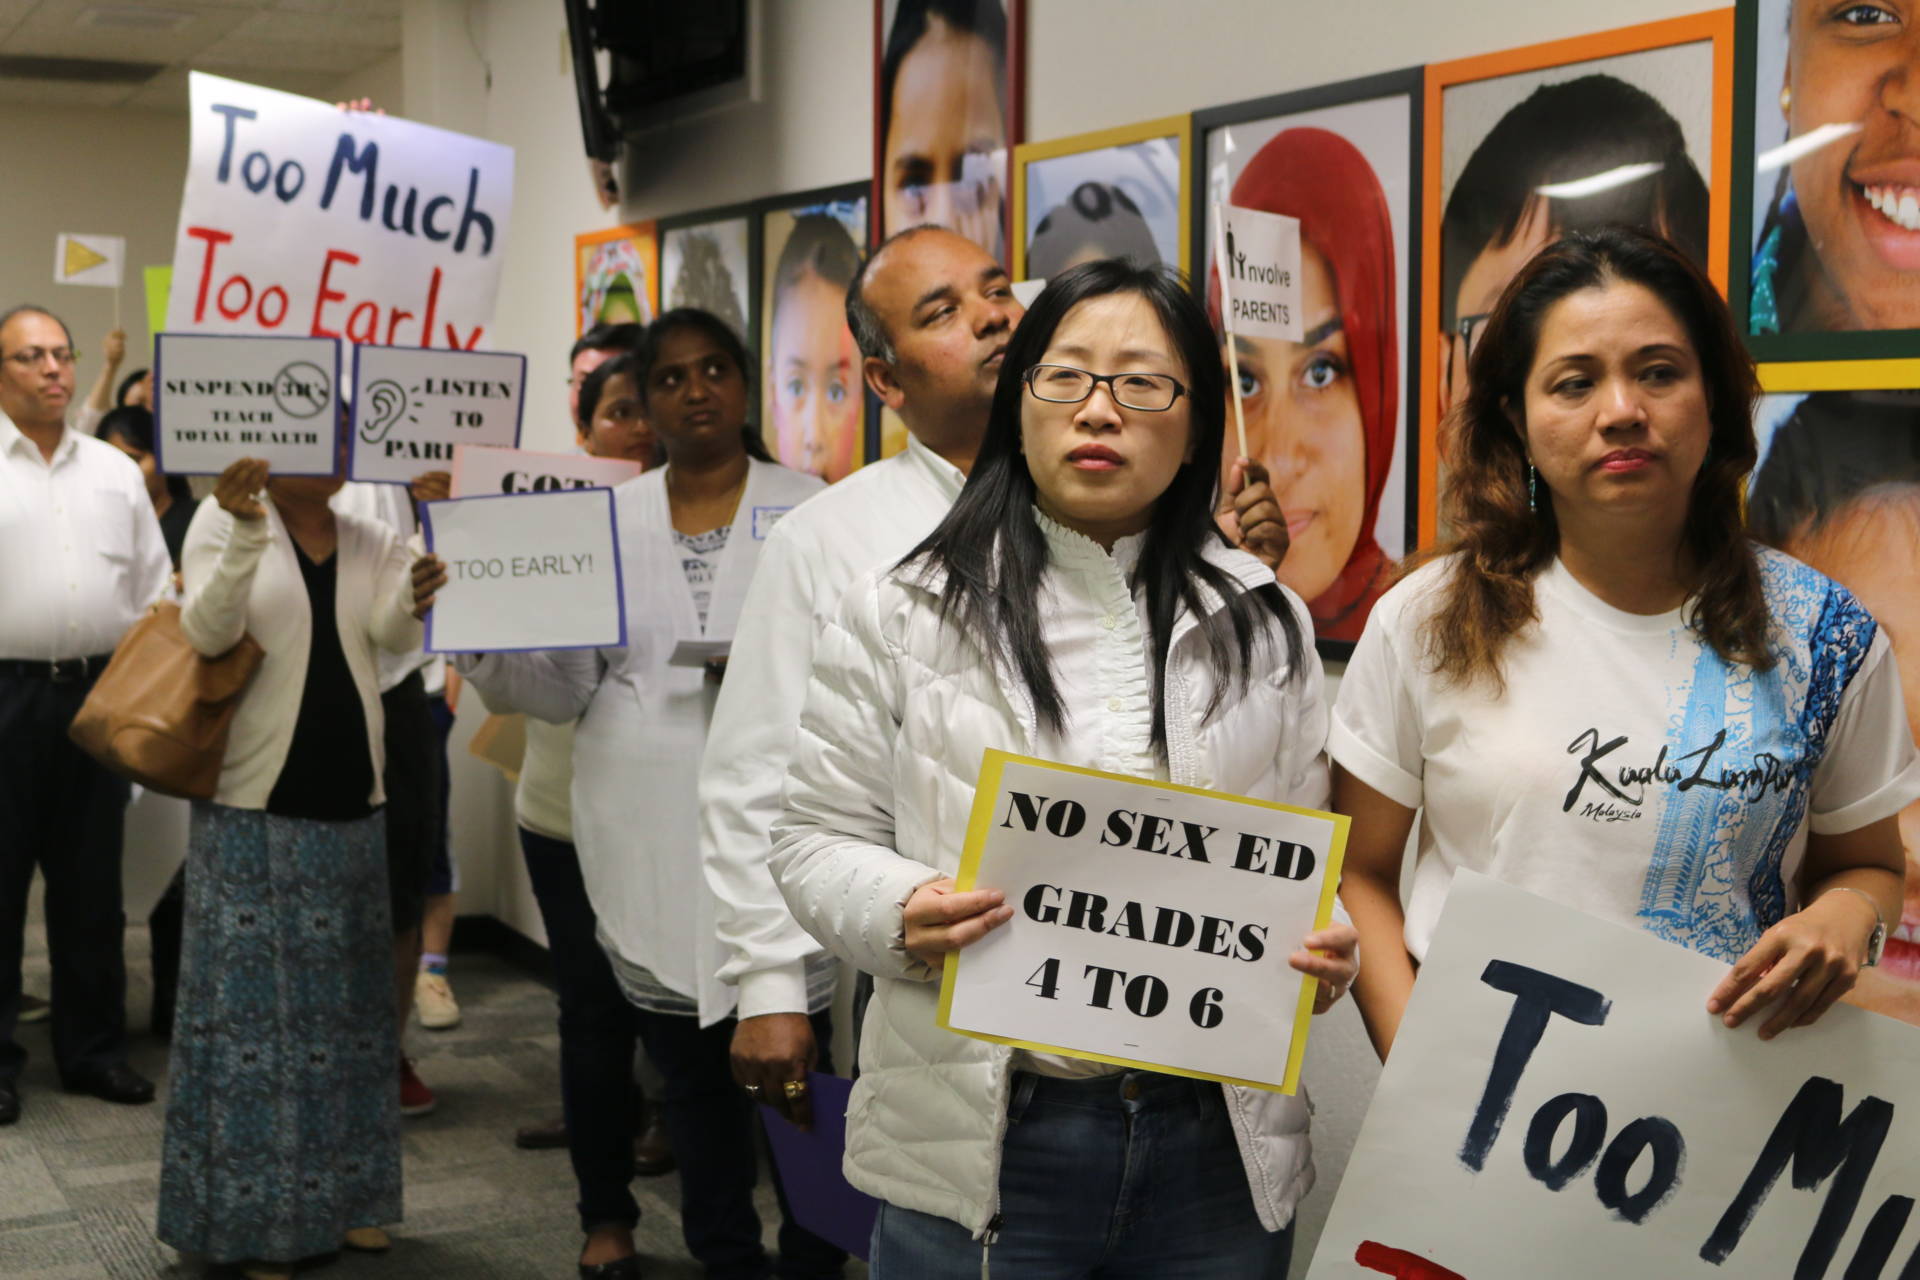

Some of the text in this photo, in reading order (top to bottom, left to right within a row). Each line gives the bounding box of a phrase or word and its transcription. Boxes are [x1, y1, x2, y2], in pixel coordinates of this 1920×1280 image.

[210, 103, 496, 257] Too Much
[187, 226, 290, 330] Too
[1232, 299, 1290, 325] PARENTS
[166, 380, 275, 396] SUSPEND
[425, 378, 513, 400] LISTEN
[211, 410, 273, 423] TEACH
[451, 410, 484, 429] TO
[174, 430, 318, 445] TOTAL HEALTH
[454, 553, 593, 580] TOO EARLY!
[1563, 727, 1682, 812] Kuala
[1579, 802, 1642, 822] Malaysia
[1000, 790, 1316, 881] NO SEX ED
[1022, 883, 1269, 963] GRADES
[1024, 956, 1225, 1029] 4 TO 6
[1457, 958, 1687, 1226] Too
